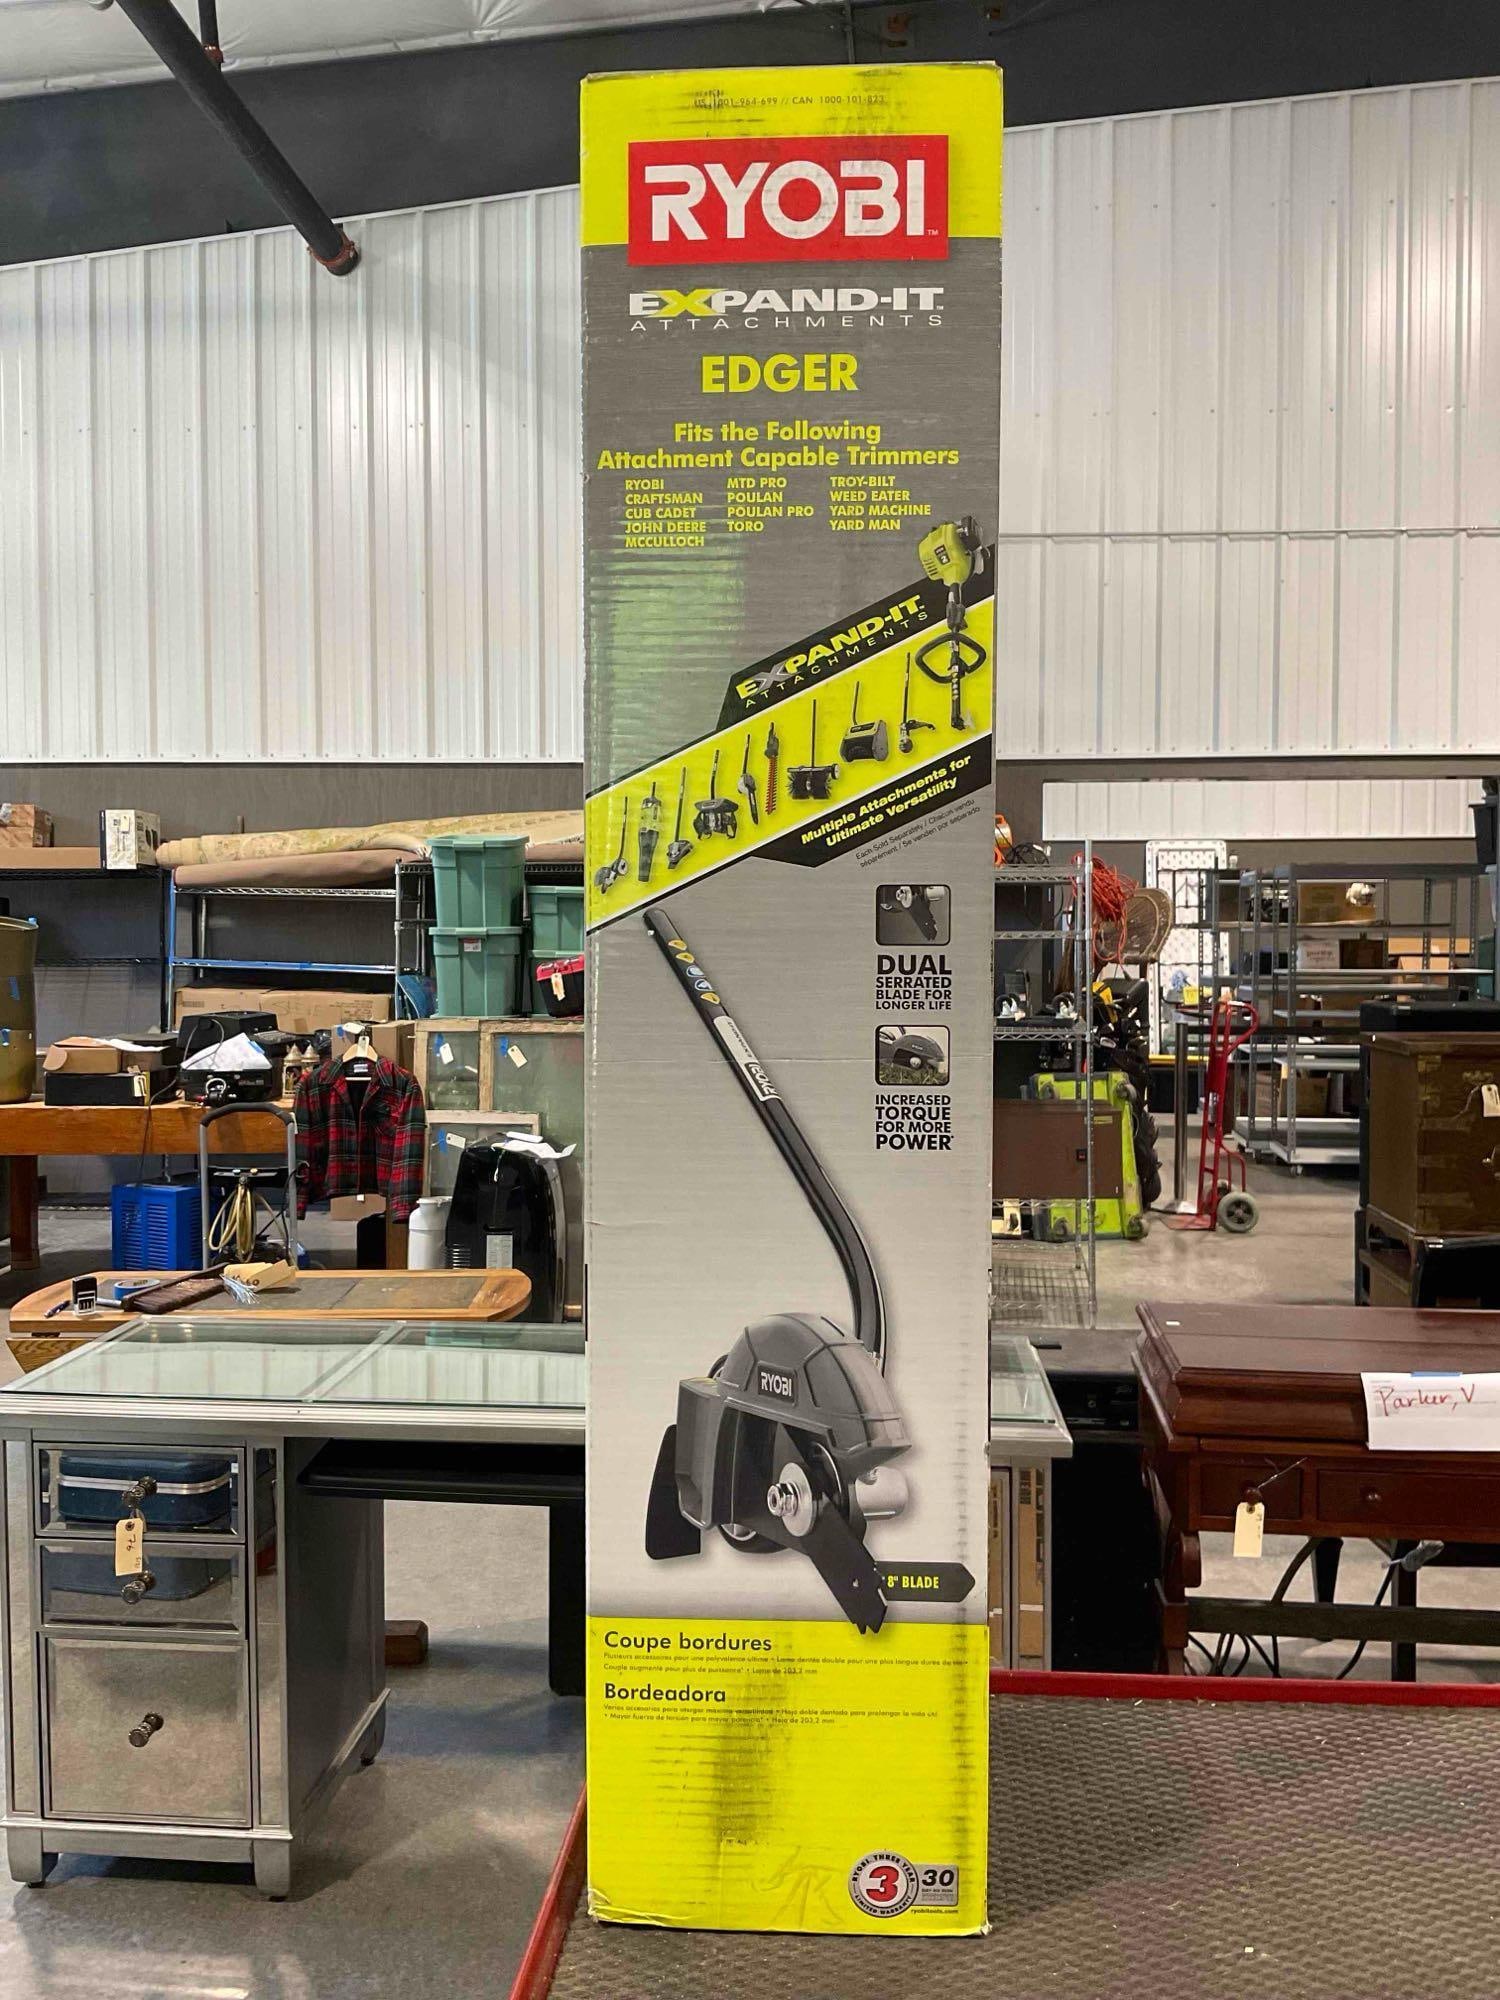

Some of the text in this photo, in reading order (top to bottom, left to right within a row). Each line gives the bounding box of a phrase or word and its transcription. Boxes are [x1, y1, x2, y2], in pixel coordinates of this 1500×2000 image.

[792, 96, 813, 104] CAN
[644, 159, 925, 241] RYOBI
[630, 288, 944, 318] EXPAND-IT
[630, 315, 942, 331] ATTACHMENTS
[702, 353, 859, 393] EDGER
[674, 420, 881, 444] Fits the Following
[597, 445, 960, 471] Attachment Capable Trimmers
[625, 479, 665, 490] RYOBI
[727, 477, 787, 489] MTD PRO
[830, 476, 896, 487] TROY-BILT
[625, 493, 703, 505] CRAFTSMAN
[727, 492, 783, 503] POULAN
[830, 490, 911, 502] WEED EATER
[625, 508, 696, 519] CUB CADET
[727, 506, 814, 517] POULAN PRO
[830, 505, 931, 516] YARD MACHINE
[625, 522, 706, 533] JOHN DEERE
[727, 521, 764, 532] TORO
[830, 520, 901, 531] YARD MAN
[625, 536, 704, 548] MCCULLOCH
[735, 594, 922, 699] EXPAND-IT
[745, 611, 928, 708] ATTACHMENTS
[801, 755, 972, 845] Multiple Attachments for
[825, 776, 958, 847] Ultimate Versatility
[855, 847, 873, 860] Each
[873, 839, 889, 851] Sold
[889, 823, 924, 844] Separately
[954, 799, 975, 812] vendu
[902, 839, 913, 848] Se
[913, 826, 938, 842] venden
[938, 820, 949, 831] por
[877, 954, 952, 976] DUAL
[876, 976, 952, 989] SERRATED
[876, 989, 952, 1000] BLADE FOR
[876, 1001, 951, 1010] LONGER LIFE
[875, 1094, 951, 1106] INCREASED
[875, 1106, 951, 1121] TORQUE
[875, 1121, 951, 1133] FOR MORE
[761, 1372, 792, 1396] RYOBI
[1376, 1384, 1475, 1416] Parker, V
[902, 1575, 939, 1589] BLADE
[604, 1631, 772, 1652] Coupe bordures
[605, 1683, 726, 1702] Bordeadora
[852, 1854, 916, 1883] RYOBI THREE YEAR
[865, 1865, 900, 1903] 3
[921, 1869, 955, 1887] 30
[854, 1894, 912, 1915] LIMITED WARRANTY
